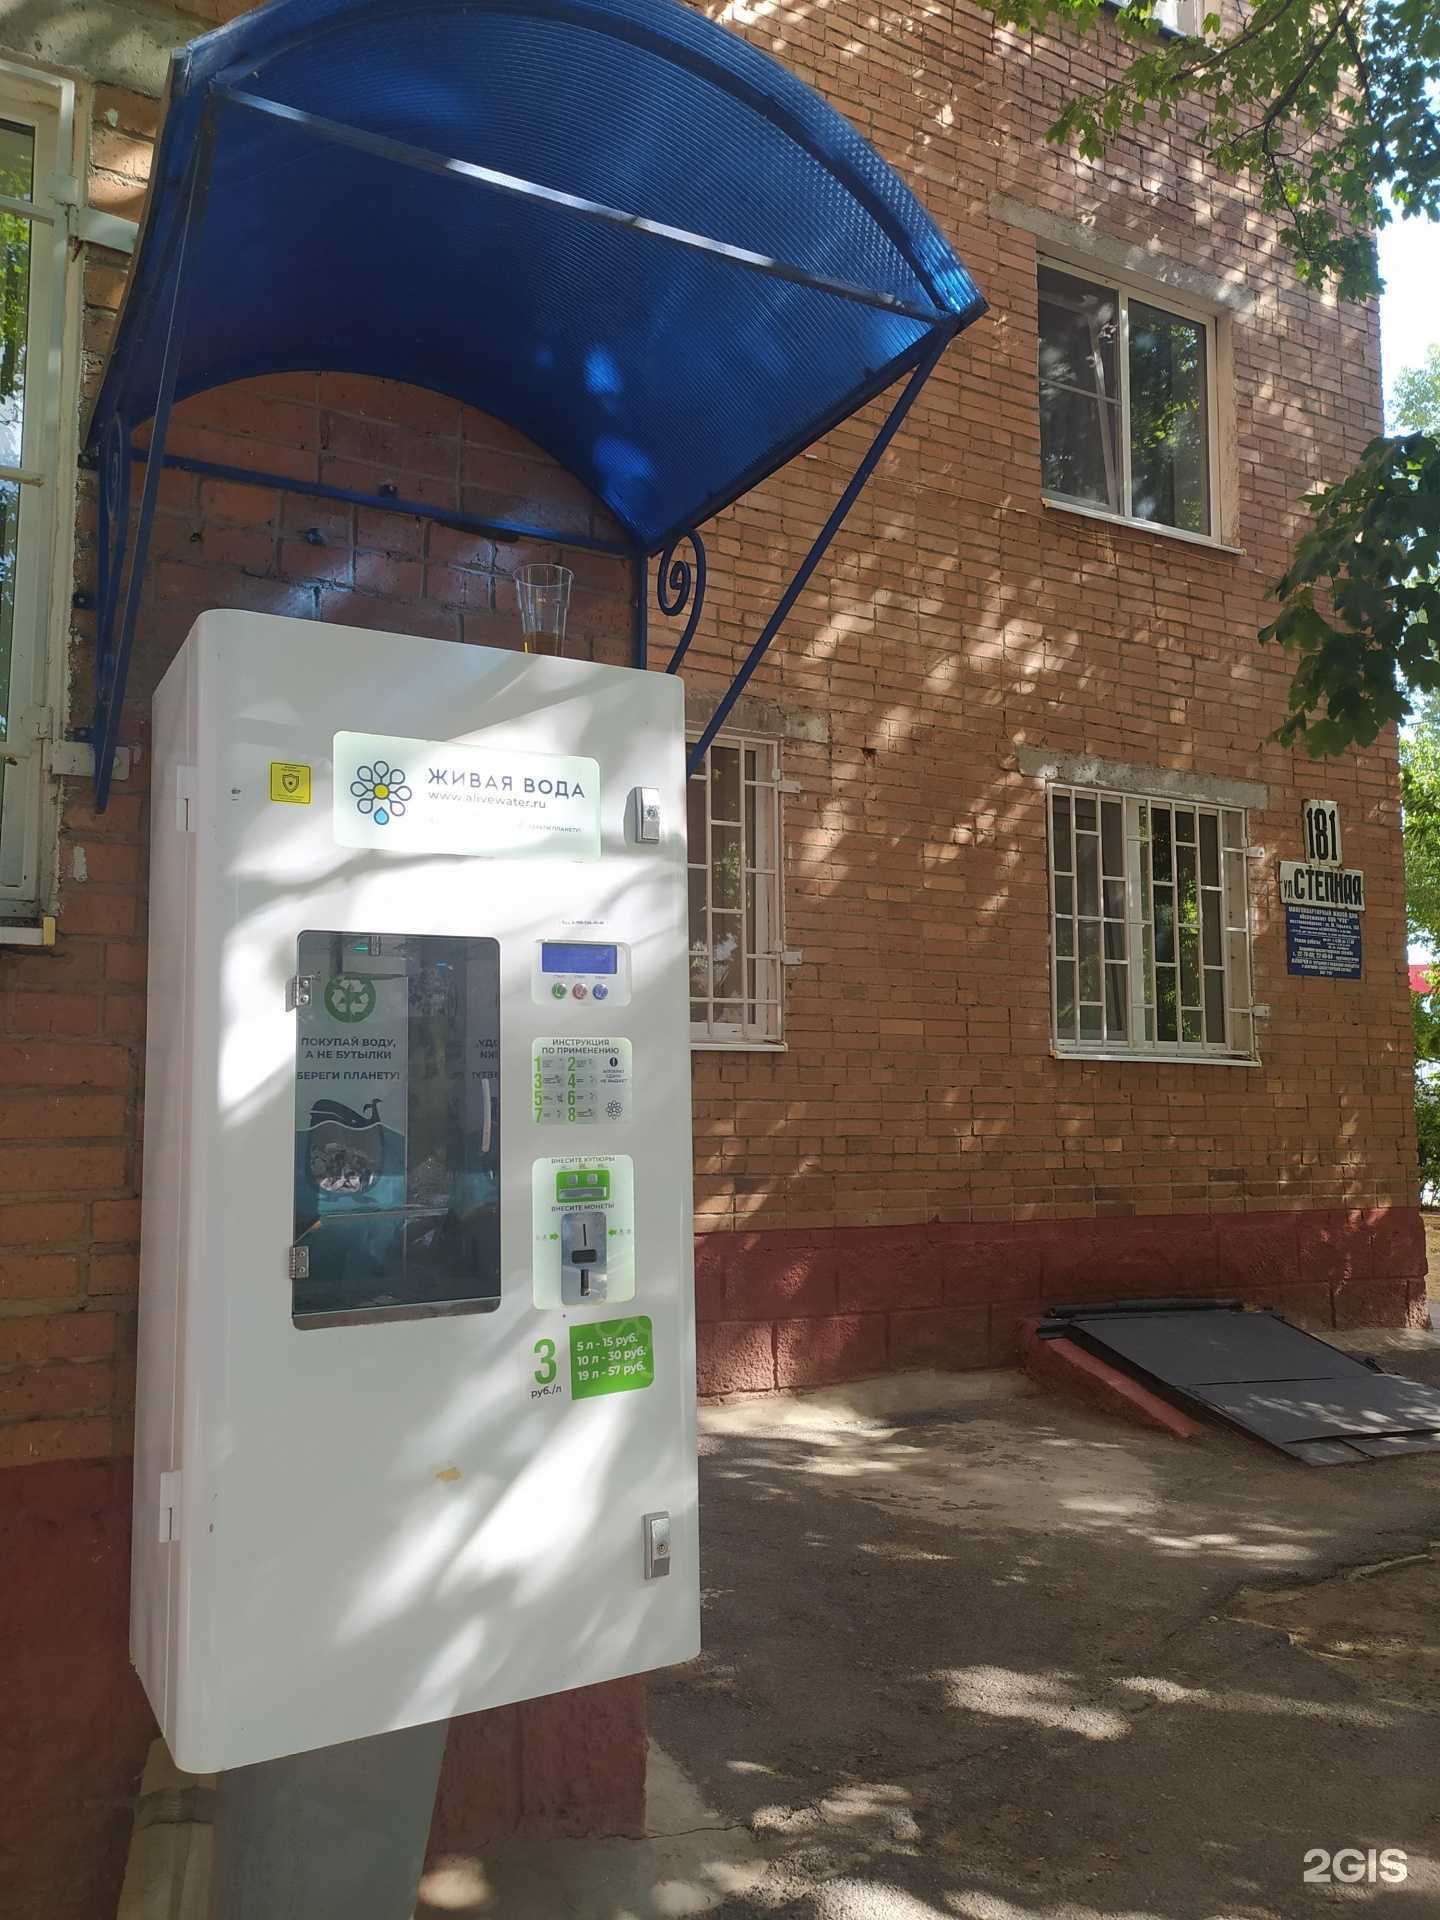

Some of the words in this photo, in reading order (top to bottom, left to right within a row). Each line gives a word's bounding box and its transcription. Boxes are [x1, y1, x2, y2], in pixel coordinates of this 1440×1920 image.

[428, 767, 513, 792] ЖИВАЯ
[524, 777, 586, 799] ВОДА
[427, 789, 547, 809] www.alivewater.ru
[1306, 807, 1338, 861] 181
[1294, 868, 1362, 906] СТЕПНАЯ
[301, 1036, 359, 1047] ПОКУПАЙ
[362, 1038, 397, 1048] ВОДУ,
[552, 1039, 610, 1047] ИНСТРУКЦИЯ
[305, 1050, 314, 1059] А
[317, 1050, 334, 1059] НЕ
[336, 1050, 392, 1059] БУТЫЛКИ
[557, 1047, 620, 1055] ПРИМЕНЕНИЮ
[534, 1056, 542, 1072] 1
[567, 1056, 576, 1072] 2
[296, 1071, 340, 1080] БЕРЕГИ
[534, 1073, 542, 1089] 3
[567, 1073, 576, 1089] 4
[534, 1090, 543, 1106] 5
[567, 1090, 576, 1106] 6
[534, 1107, 543, 1123] 7
[568, 1106, 577, 1122] 8
[576, 1341, 584, 1352] 5
[586, 1341, 593, 1350] л
[602, 1337, 613, 1347] 15
[615, 1333, 638, 1347] руб.
[533, 1338, 557, 1385] 3
[576, 1356, 589, 1366] 10
[591, 1355, 599, 1364] л
[608, 1351, 622, 1361] 30
[624, 1346, 646, 1360] руб.
[577, 1371, 589, 1381] 19
[591, 1370, 599, 1379] л
[608, 1366, 621, 1376] 57
[623, 1361, 646, 1376] руб.
[531, 1384, 562, 1399] руб./л
